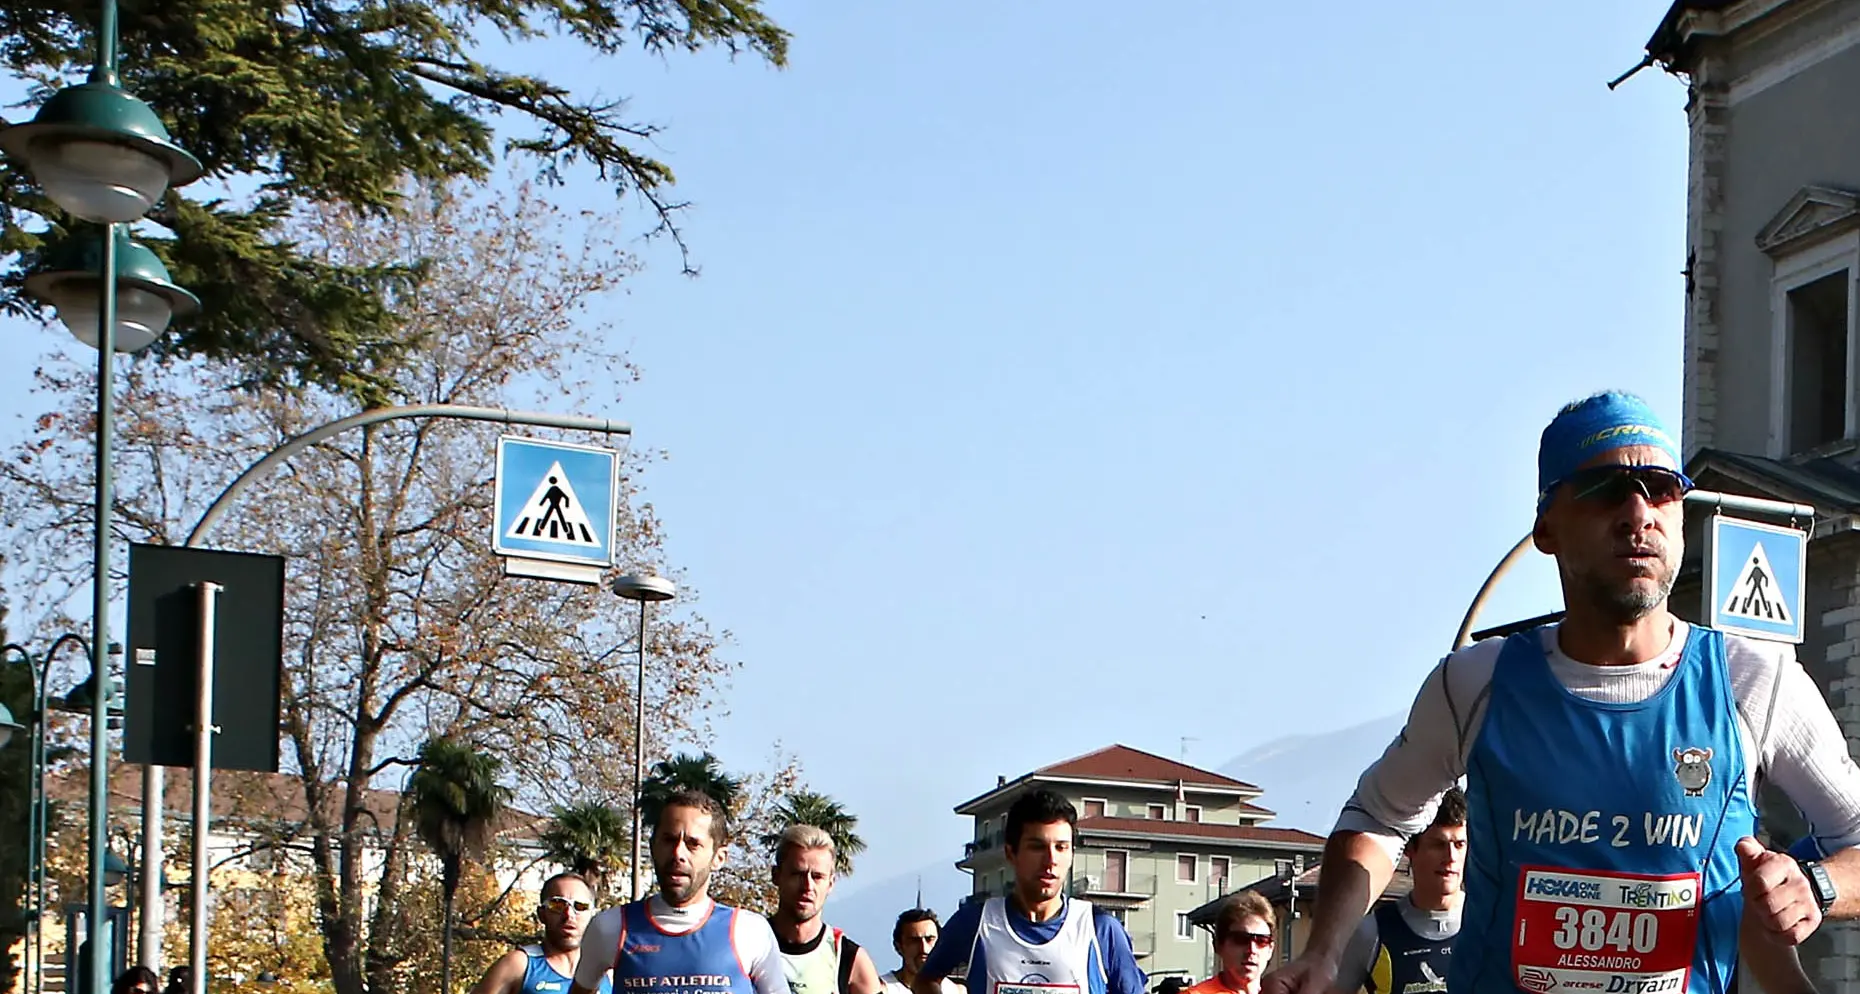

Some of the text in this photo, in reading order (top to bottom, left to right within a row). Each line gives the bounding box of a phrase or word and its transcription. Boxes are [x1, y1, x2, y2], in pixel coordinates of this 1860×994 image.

[1512, 808, 1704, 850] MADE 2 WIN
[1527, 877, 1601, 899] HOKA ONE
[1579, 890, 1601, 900] ONE
[1619, 884, 1693, 909] TRENTINO
[1553, 906, 1658, 954] 3840
[1557, 953, 1642, 969] ALESSANDRO
[624, 974, 732, 988] SELF ATLETICA
[1562, 981, 1604, 989] arcese
